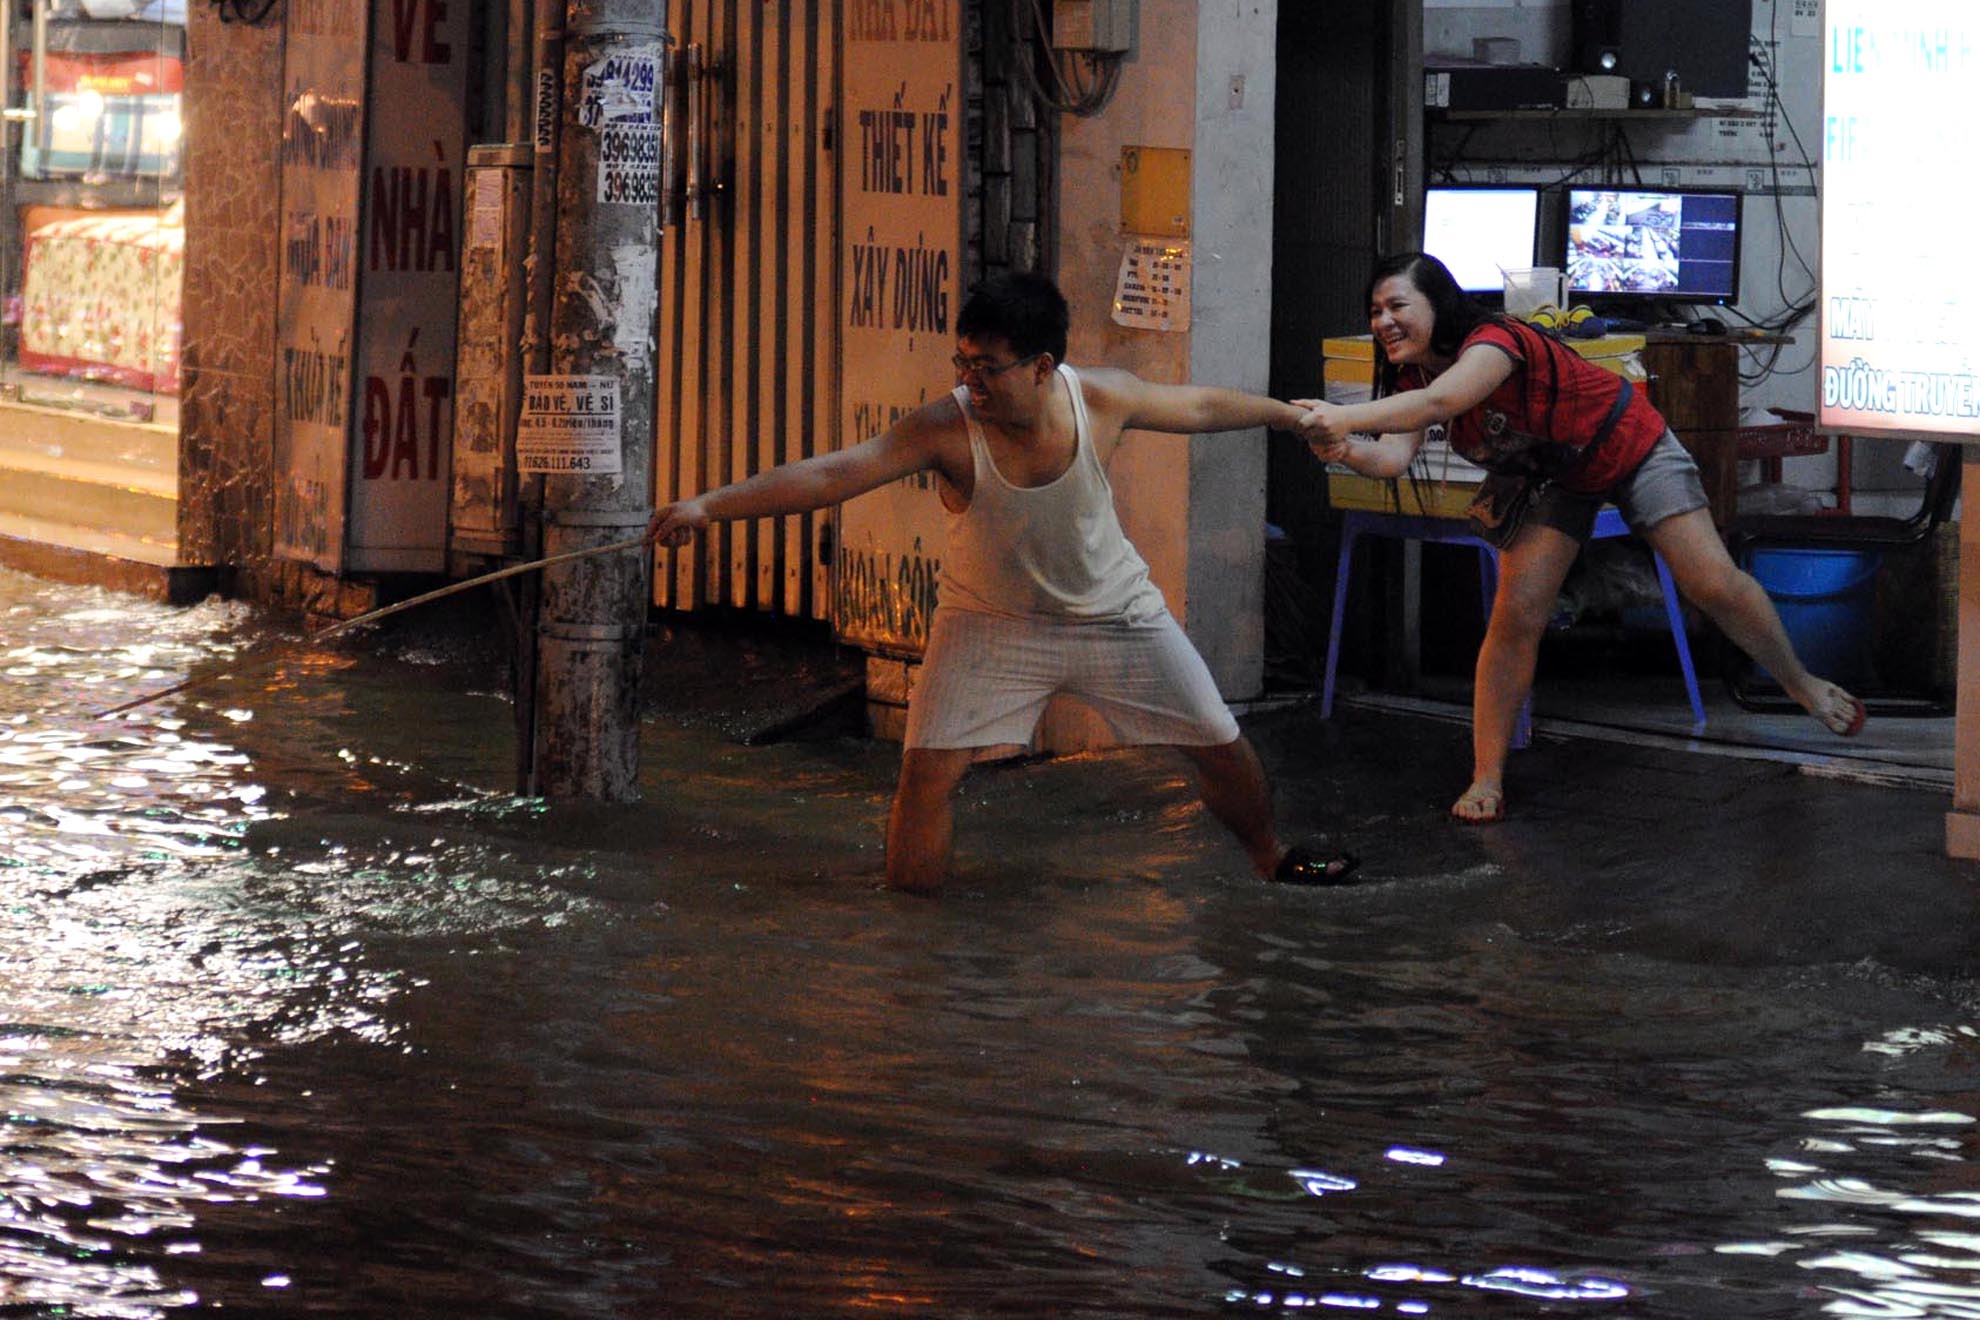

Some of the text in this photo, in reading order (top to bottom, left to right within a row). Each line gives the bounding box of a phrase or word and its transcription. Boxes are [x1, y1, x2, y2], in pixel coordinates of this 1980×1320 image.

[923, 83, 952, 197] KẾ
[370, 141, 455, 273] NHÀ
[850, 225, 889, 330] XÂY
[361, 327, 450, 481] ĐẤT
[1824, 356, 1897, 414] ĐƯỜNG
